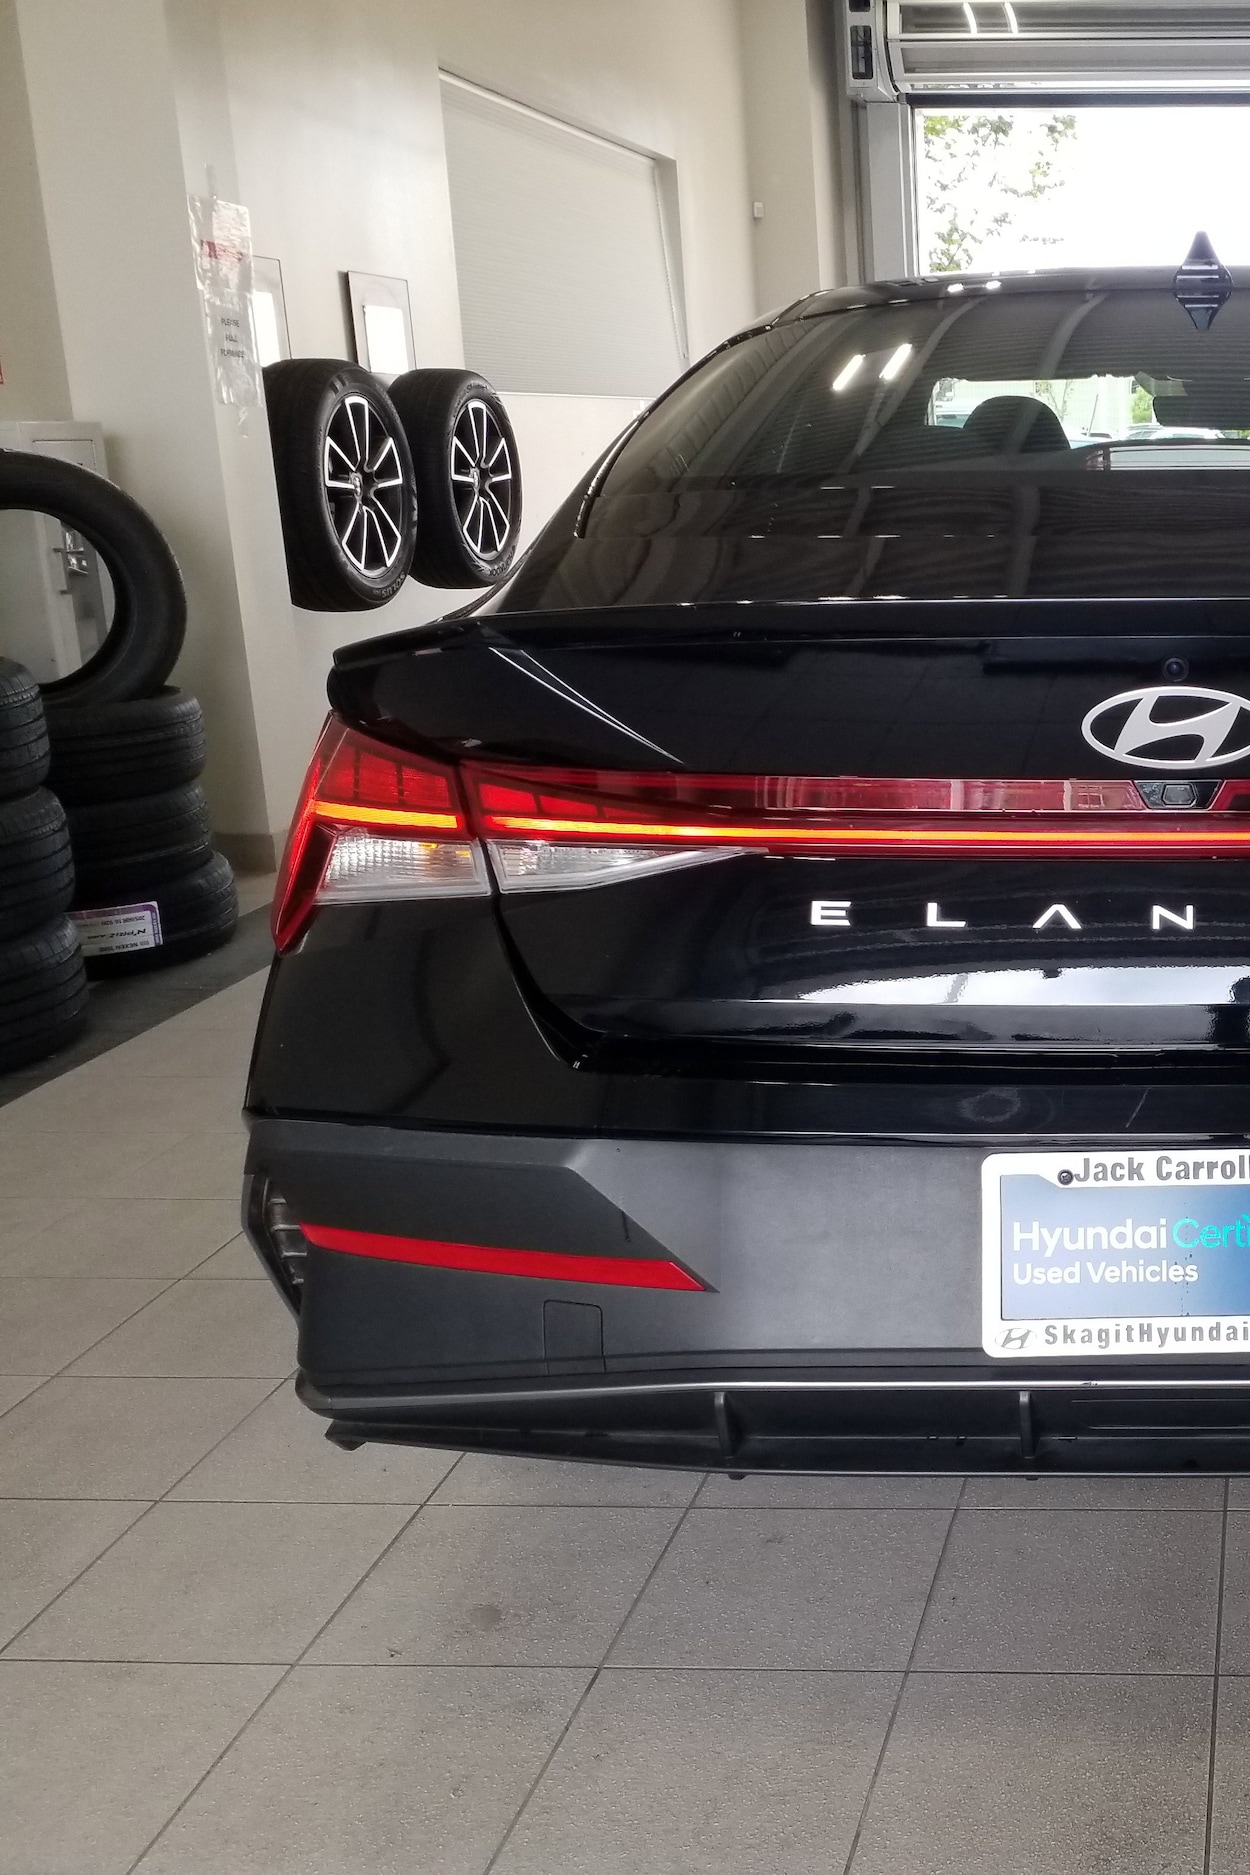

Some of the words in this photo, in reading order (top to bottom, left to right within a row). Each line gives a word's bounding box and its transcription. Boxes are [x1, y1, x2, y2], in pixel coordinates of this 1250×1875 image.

[116, 942, 138, 950] NEXEN
[1073, 1157, 1145, 1182] Jack
[1012, 1218, 1167, 1257] Hyundai
[1012, 1261, 1081, 1285] Used
[1086, 1260, 1199, 1283] Vehicles
